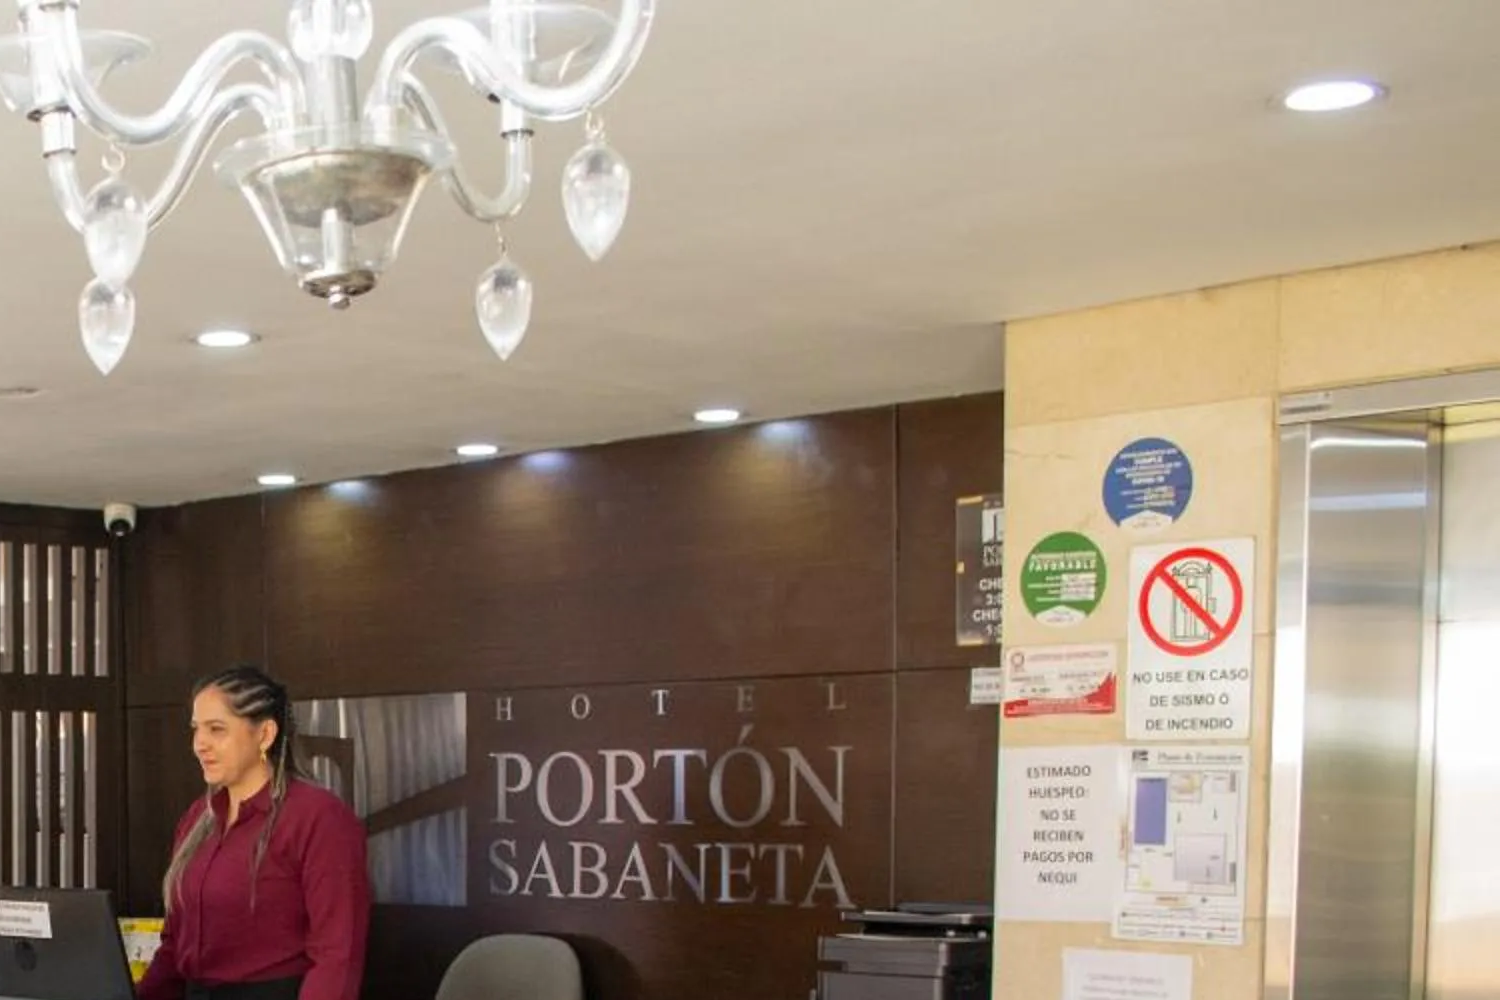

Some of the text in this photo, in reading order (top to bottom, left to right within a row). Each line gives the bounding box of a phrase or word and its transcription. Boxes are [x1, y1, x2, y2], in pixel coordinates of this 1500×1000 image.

[1133, 668, 1249, 684] NO USE EN CASO
[1149, 695, 1169, 707] DE
[1171, 693, 1215, 706] SISMO
[1145, 717, 1233, 731] DE INCENDIO
[488, 724, 852, 827] PORTÓN
[1026, 765, 1091, 779] ESTIMADO
[1040, 809, 1076, 821] NO SE
[1033, 830, 1084, 842] RECIBEN
[1023, 851, 1093, 863] PAGOS POR
[489, 839, 857, 909] SABANETA
[1037, 871, 1077, 884] NEQUI
